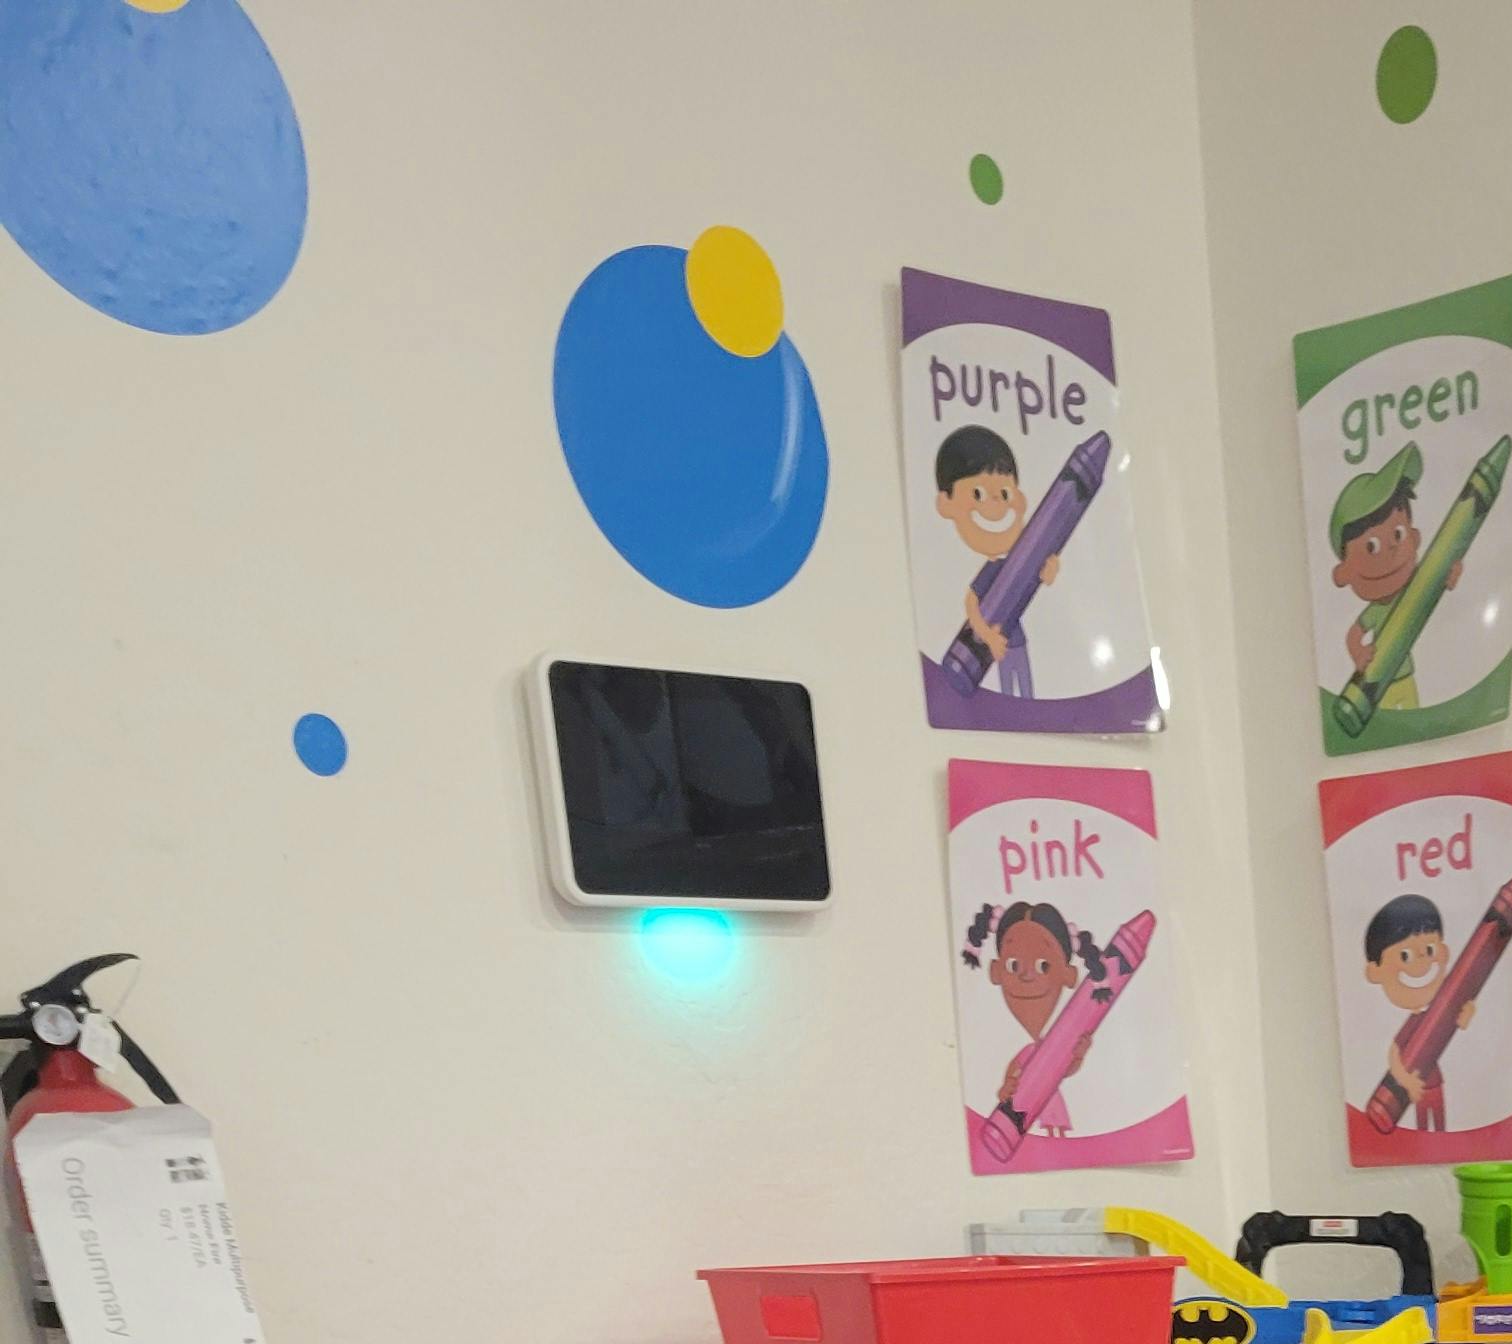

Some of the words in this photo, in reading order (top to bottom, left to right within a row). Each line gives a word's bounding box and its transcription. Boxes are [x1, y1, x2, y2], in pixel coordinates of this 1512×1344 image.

[929, 355, 1088, 434] purple
[1342, 369, 1480, 466] green
[999, 819, 1106, 894] pink
[1396, 814, 1474, 881] red
[61, 1157, 93, 1224] Order
[79, 1228, 131, 1338] summary
